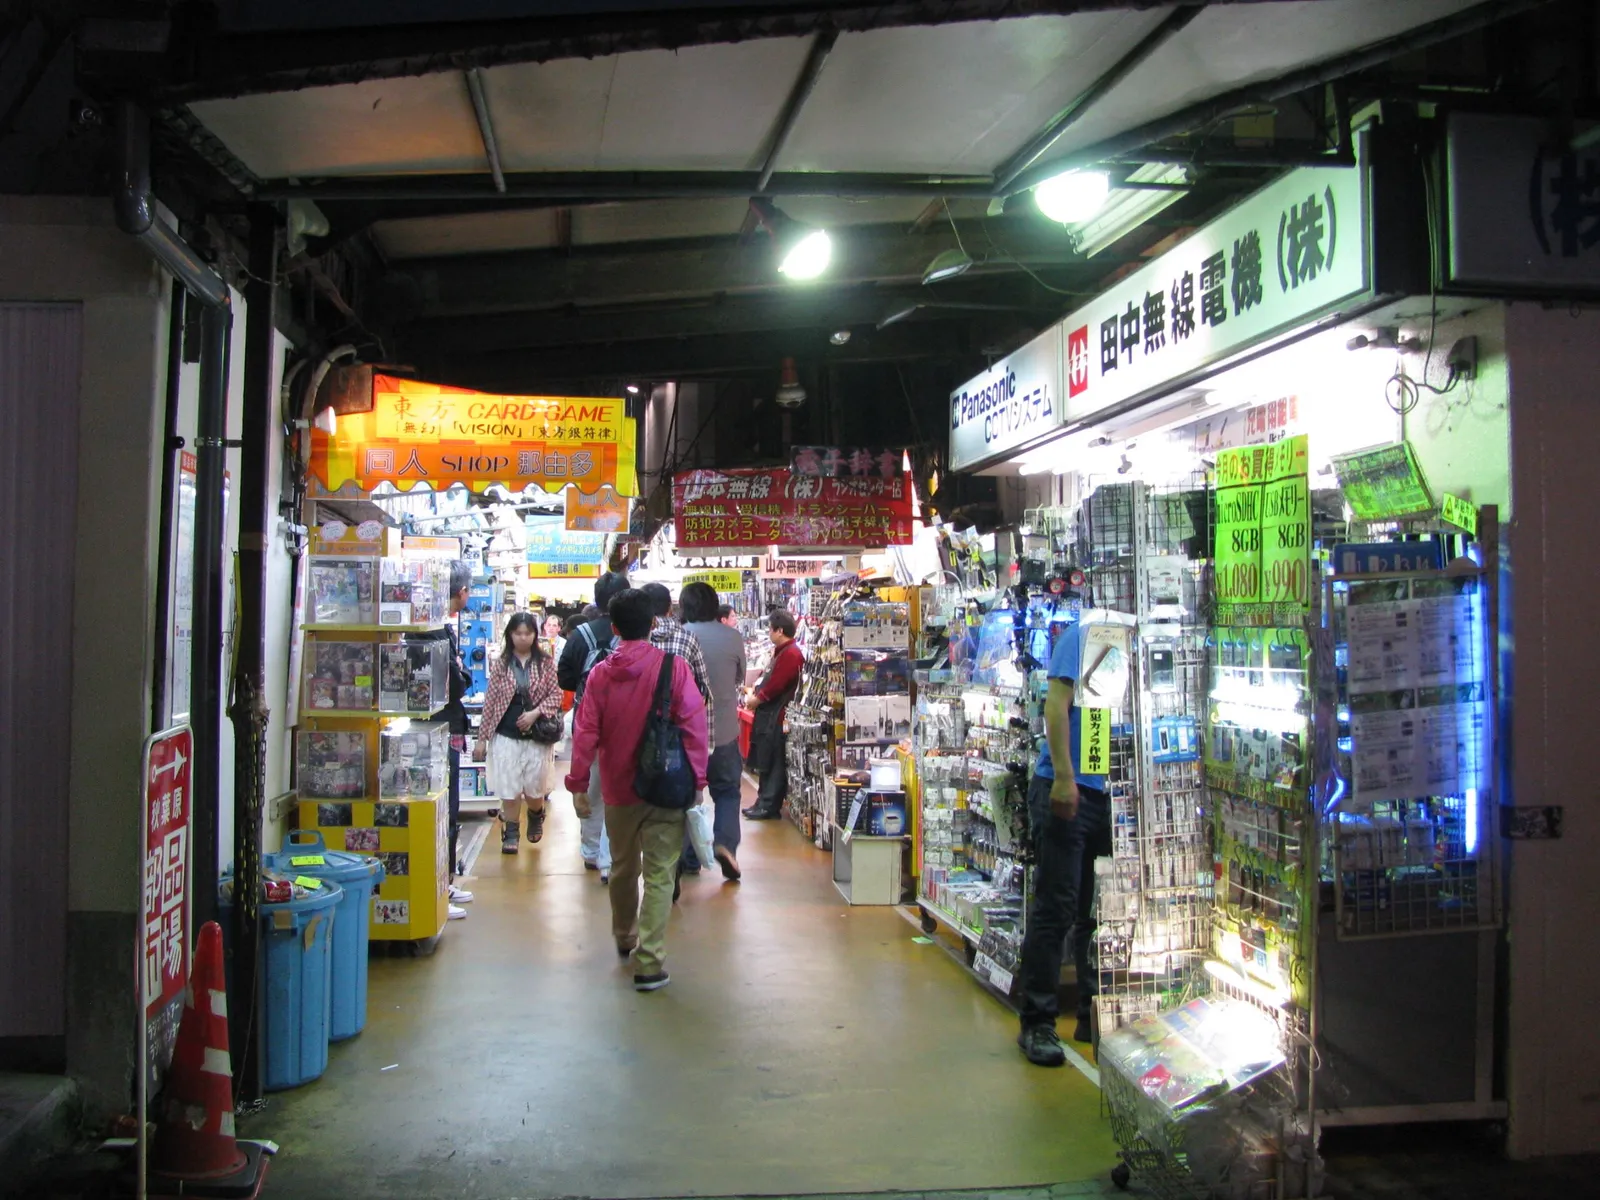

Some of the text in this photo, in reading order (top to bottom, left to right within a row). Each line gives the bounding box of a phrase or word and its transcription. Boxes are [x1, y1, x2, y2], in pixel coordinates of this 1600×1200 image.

[1100, 230, 1263, 377] 田中無線電機
[467, 402, 537, 421] CARD
[544, 404, 615, 423] GAME
[961, 366, 1016, 424] Panasonic
[985, 384, 1052, 444] CCTVシステム
[366, 448, 594, 477] 同人 SHOP 那由多
[1232, 528, 1259, 552] 8GB
[1278, 523, 1305, 548] 8GB
[1264, 559, 1306, 601] ¥990
[151, 786, 182, 834] 秋葉原
